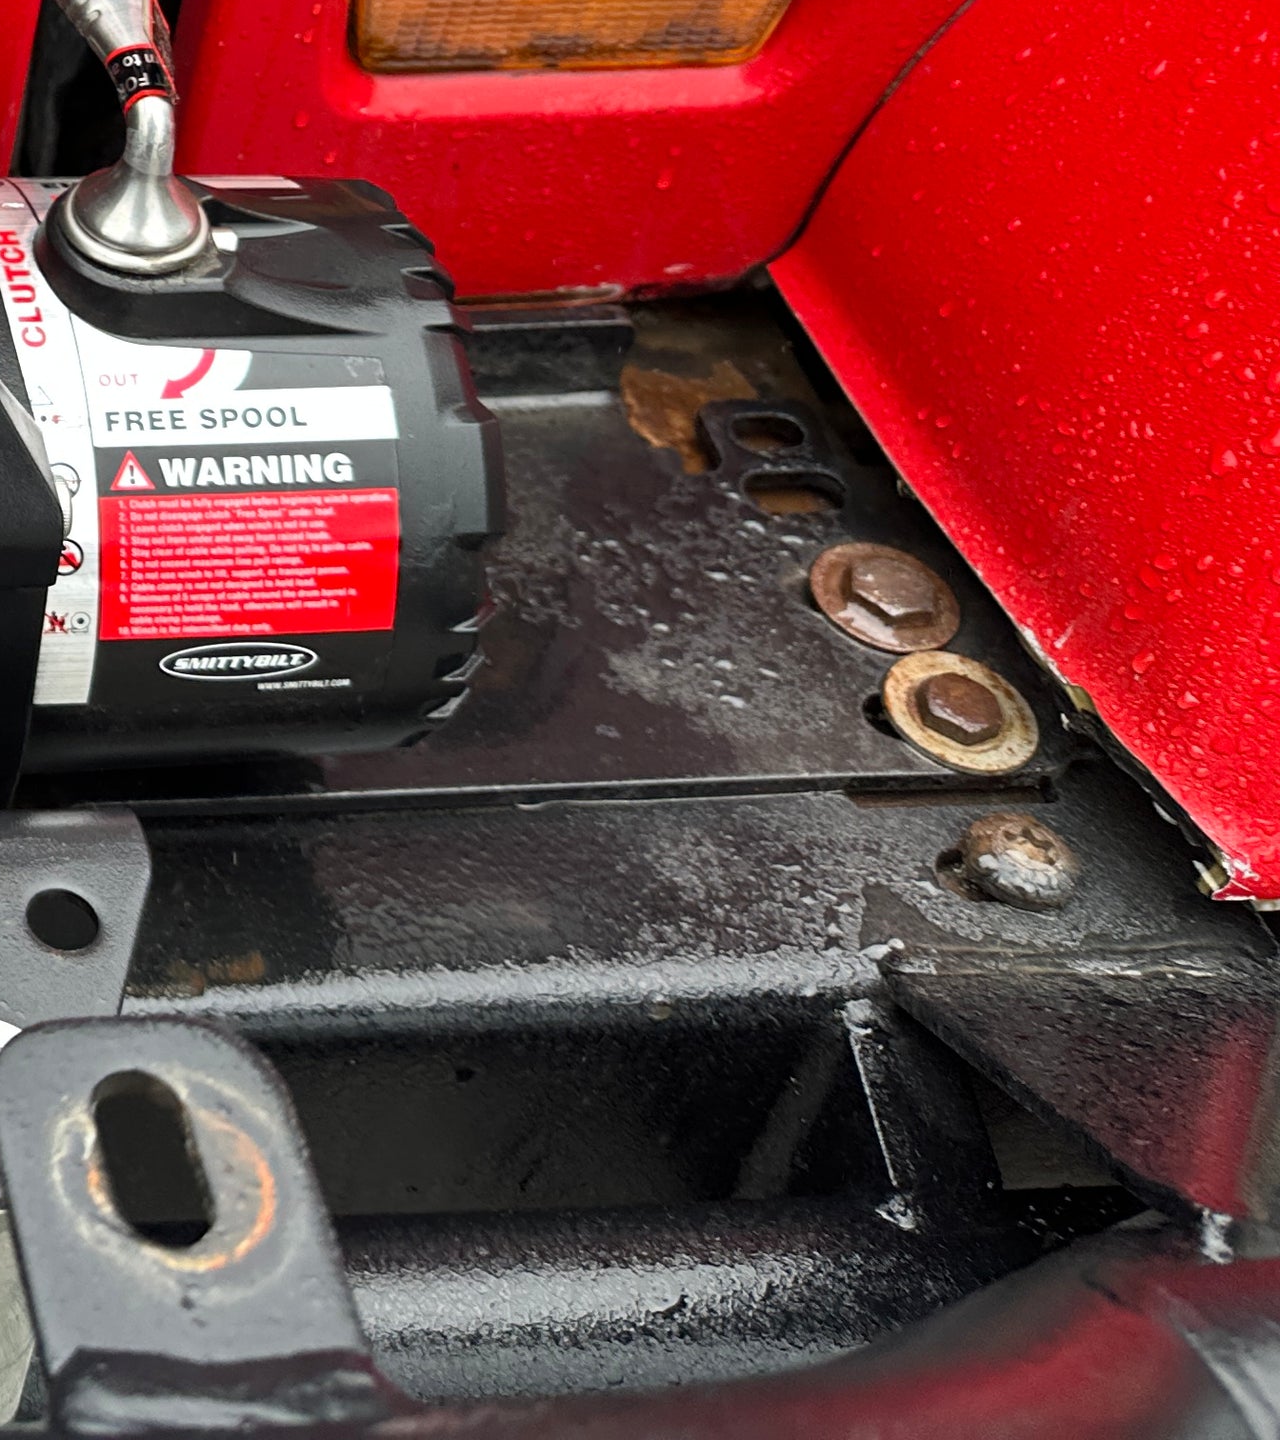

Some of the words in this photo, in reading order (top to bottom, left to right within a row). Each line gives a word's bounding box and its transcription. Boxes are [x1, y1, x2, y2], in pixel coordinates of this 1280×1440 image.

[98, 373, 139, 387] OUT
[105, 410, 188, 432] FREE
[199, 406, 308, 430] SPOOL
[158, 452, 355, 488] WARNING
[173, 653, 305, 671] SMITTYBILT
